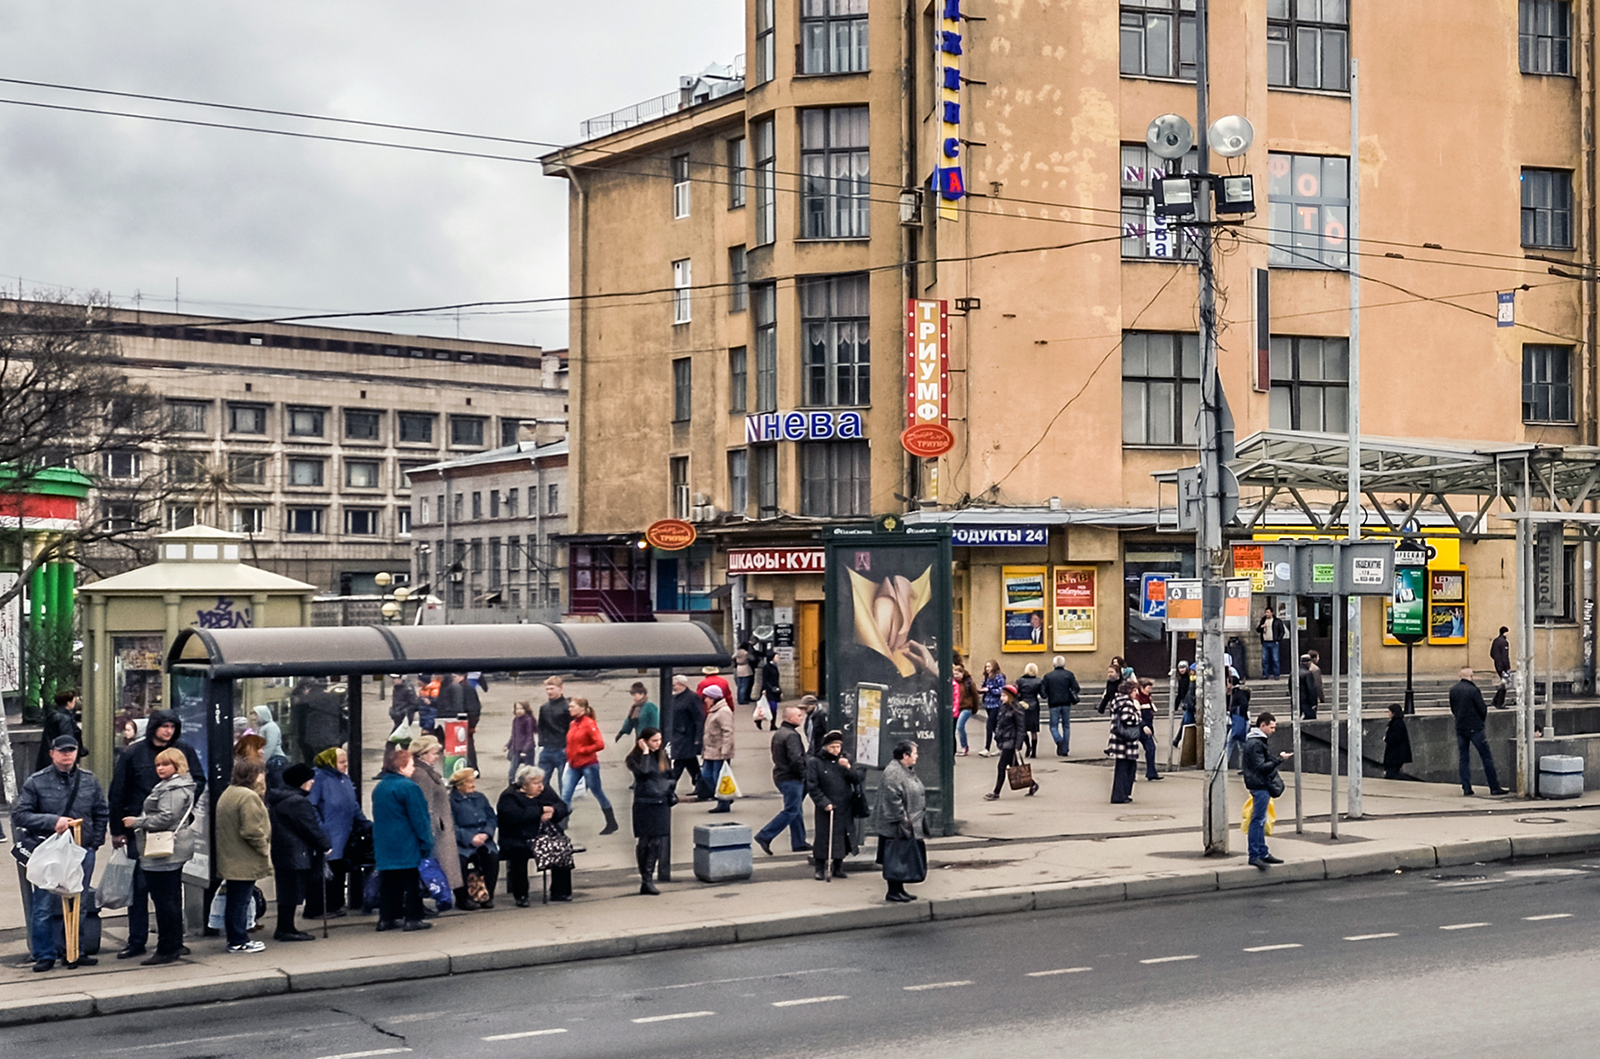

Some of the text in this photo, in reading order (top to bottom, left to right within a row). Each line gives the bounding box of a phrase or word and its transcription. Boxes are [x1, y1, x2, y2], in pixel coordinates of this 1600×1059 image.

[917, 301, 939, 421] ТРИУМФ
[1025, 529, 1044, 542] 24
[729, 553, 780, 569] ШКАФЫ
[916, 730, 935, 739] VISA
